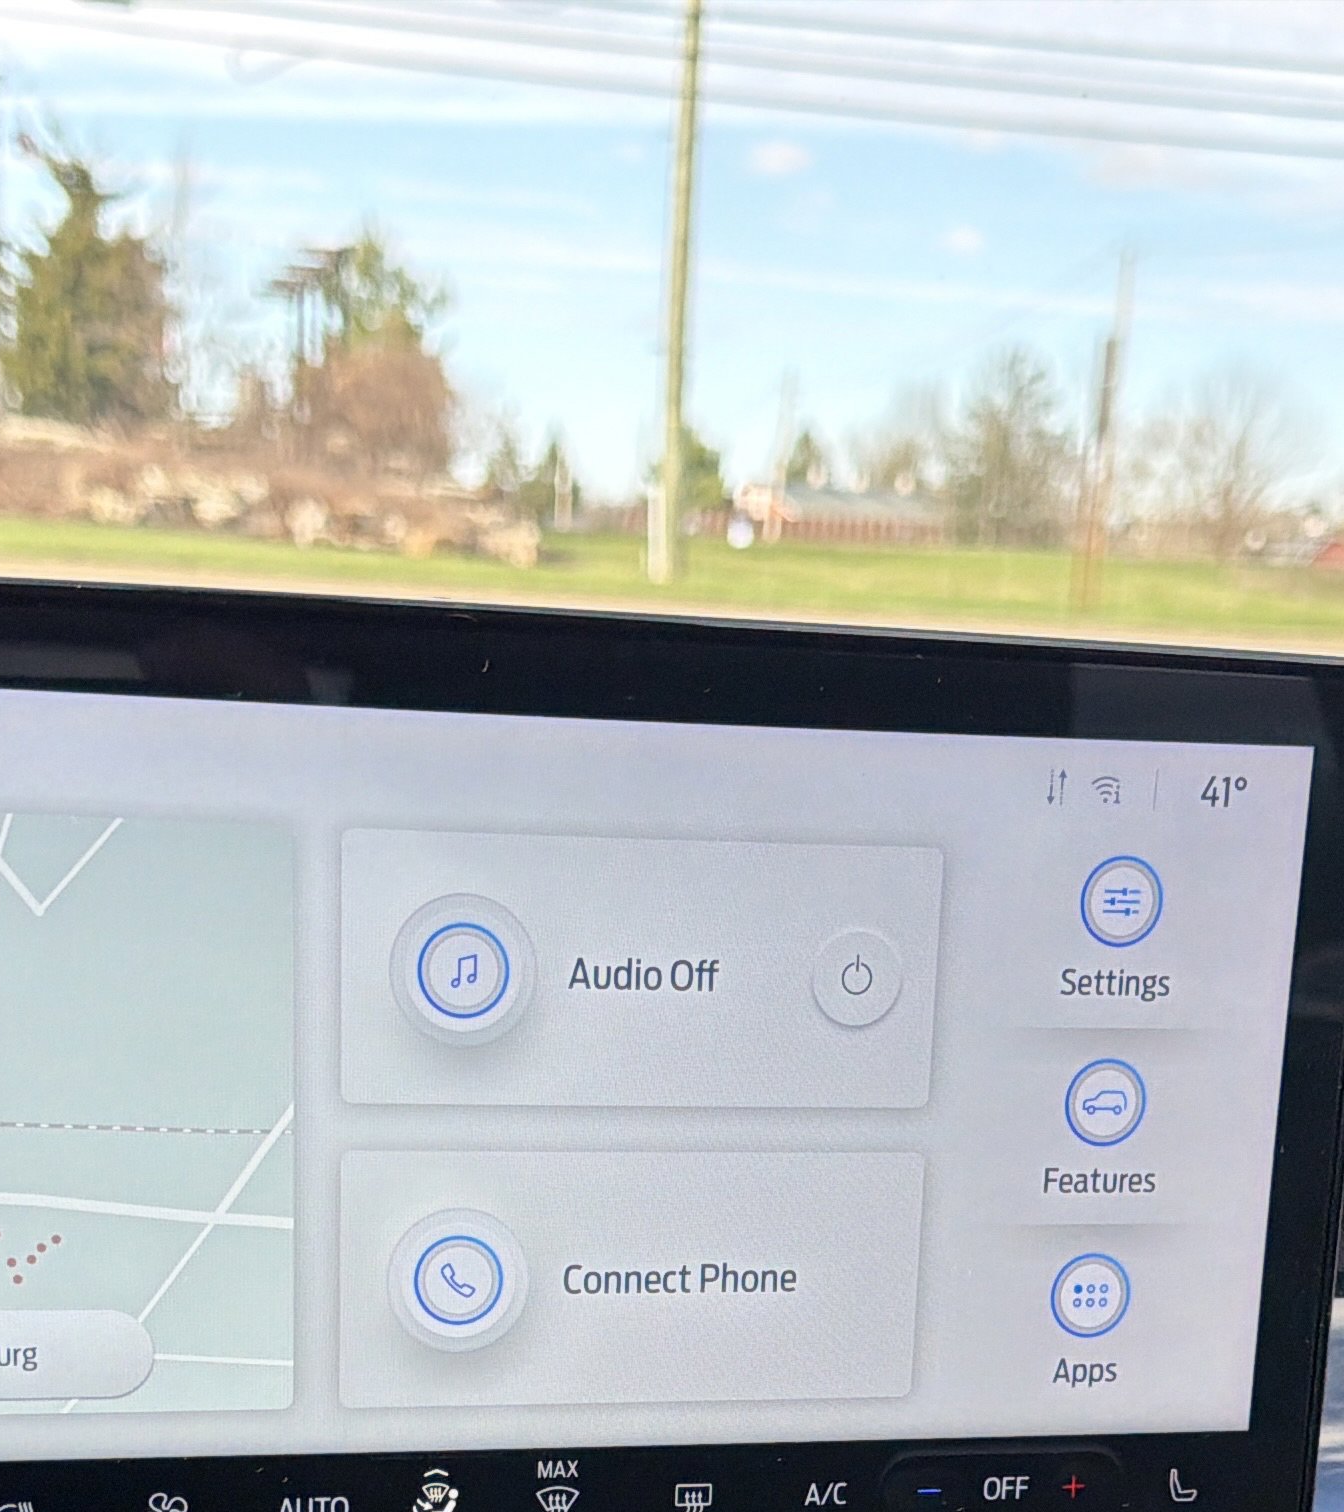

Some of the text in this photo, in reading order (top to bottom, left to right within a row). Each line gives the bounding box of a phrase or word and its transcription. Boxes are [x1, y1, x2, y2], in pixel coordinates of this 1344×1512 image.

[1200, 775, 1248, 808] 41°
[568, 957, 720, 992] Audio Off
[1060, 968, 1170, 1002] Settings
[1043, 1166, 1156, 1195] Features
[563, 1262, 797, 1295] Connect Phone
[1052, 1357, 1118, 1388] Apps
[537, 1459, 579, 1479] MAX
[804, 1481, 848, 1506] A/C
[983, 1475, 1030, 1501] OFF
